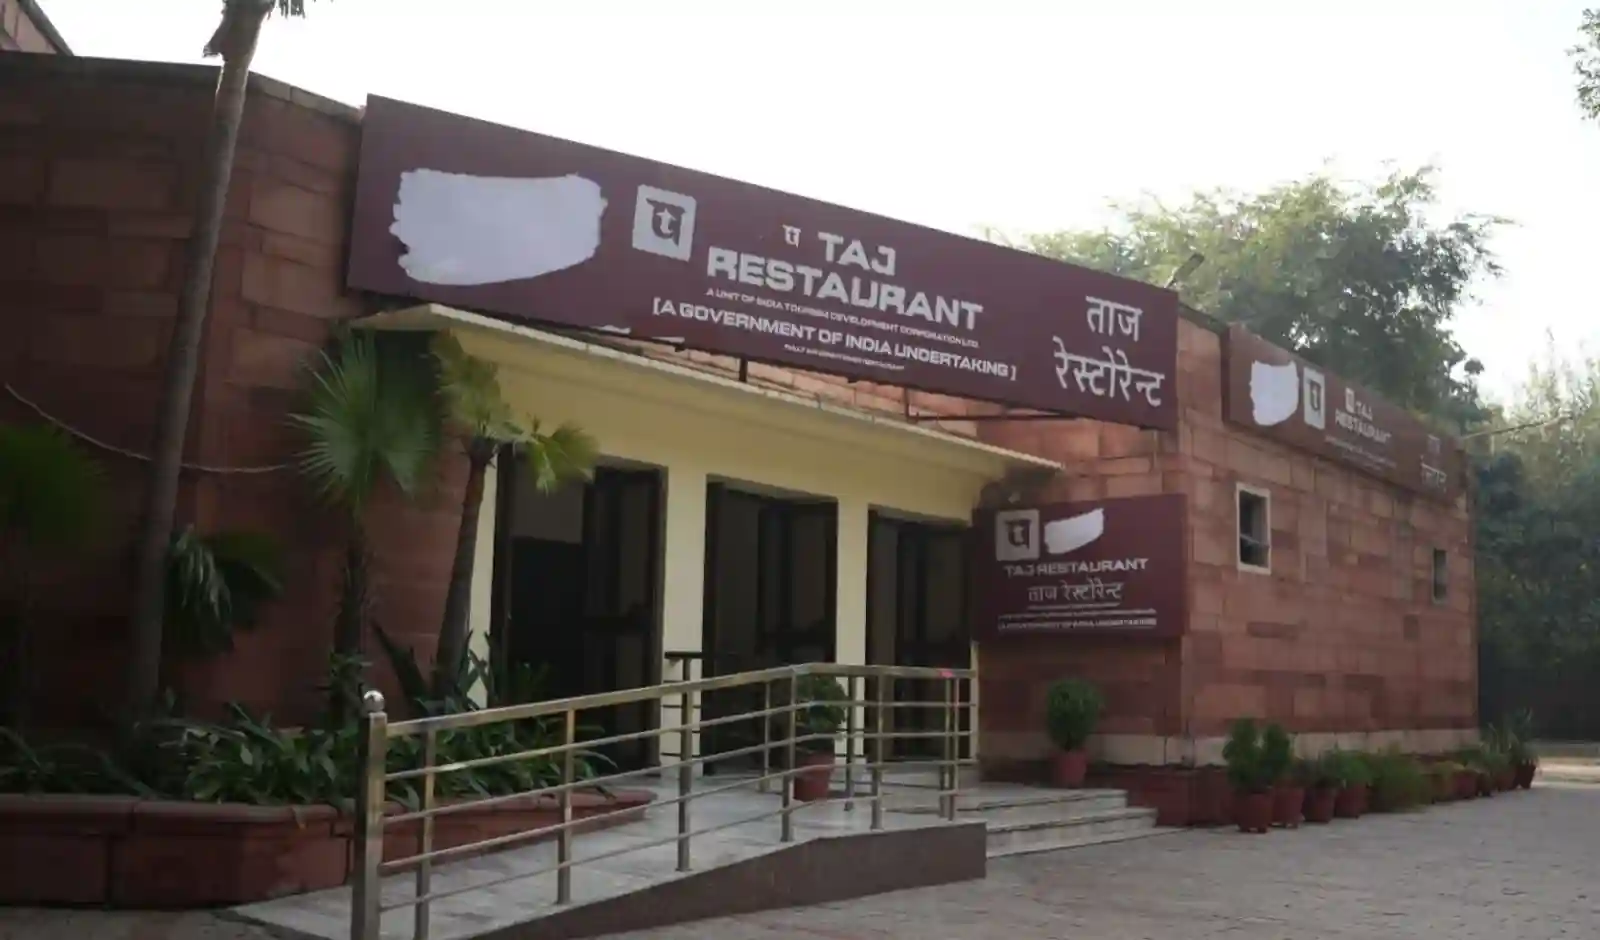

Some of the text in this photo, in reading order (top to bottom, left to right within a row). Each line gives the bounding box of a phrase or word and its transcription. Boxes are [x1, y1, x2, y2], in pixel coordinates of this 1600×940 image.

[817, 231, 897, 277] TAJ
[706, 288, 714, 297] A
[707, 245, 984, 331] RESTAURANT
[679, 302, 817, 341] GOVERNMENT
[818, 329, 843, 345] OF
[845, 334, 892, 356] INDIA
[1085, 295, 1144, 342] ताज
[1052, 335, 1166, 408] रेस्टोरेन्ट
[1003, 557, 1150, 578] TAJ RESTAURANT
[1027, 585, 1058, 602] ताज
